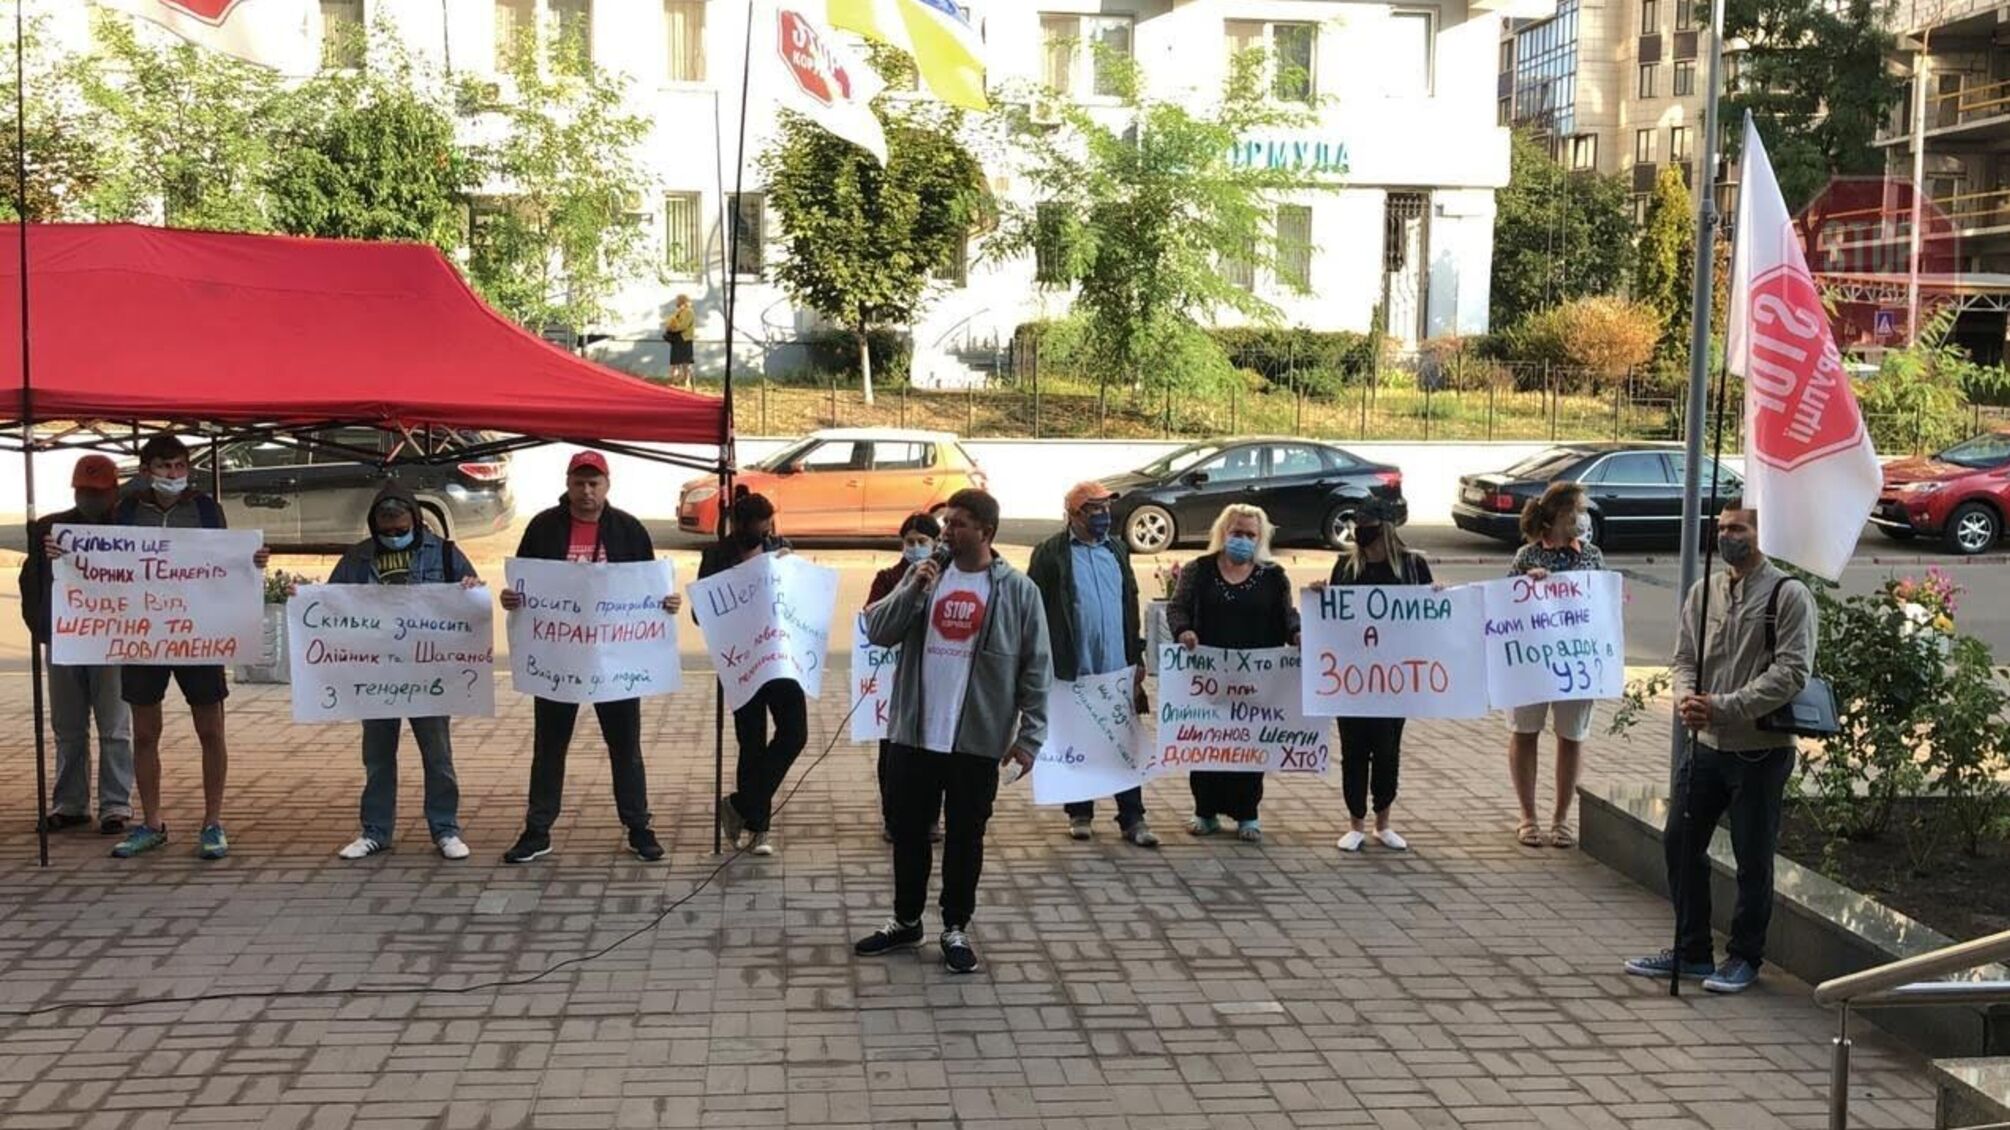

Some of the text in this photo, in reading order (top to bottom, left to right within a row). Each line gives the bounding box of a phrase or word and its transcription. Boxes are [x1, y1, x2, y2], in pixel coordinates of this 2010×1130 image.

[303, 601, 381, 629] Скільки
[943, 600, 977, 619] STOP
[1320, 588, 1356, 620] НЕ
[532, 617, 666, 644] КАРАНТИНОМ
[306, 639, 380, 664] Олійник
[1189, 676, 1218, 696] 50
